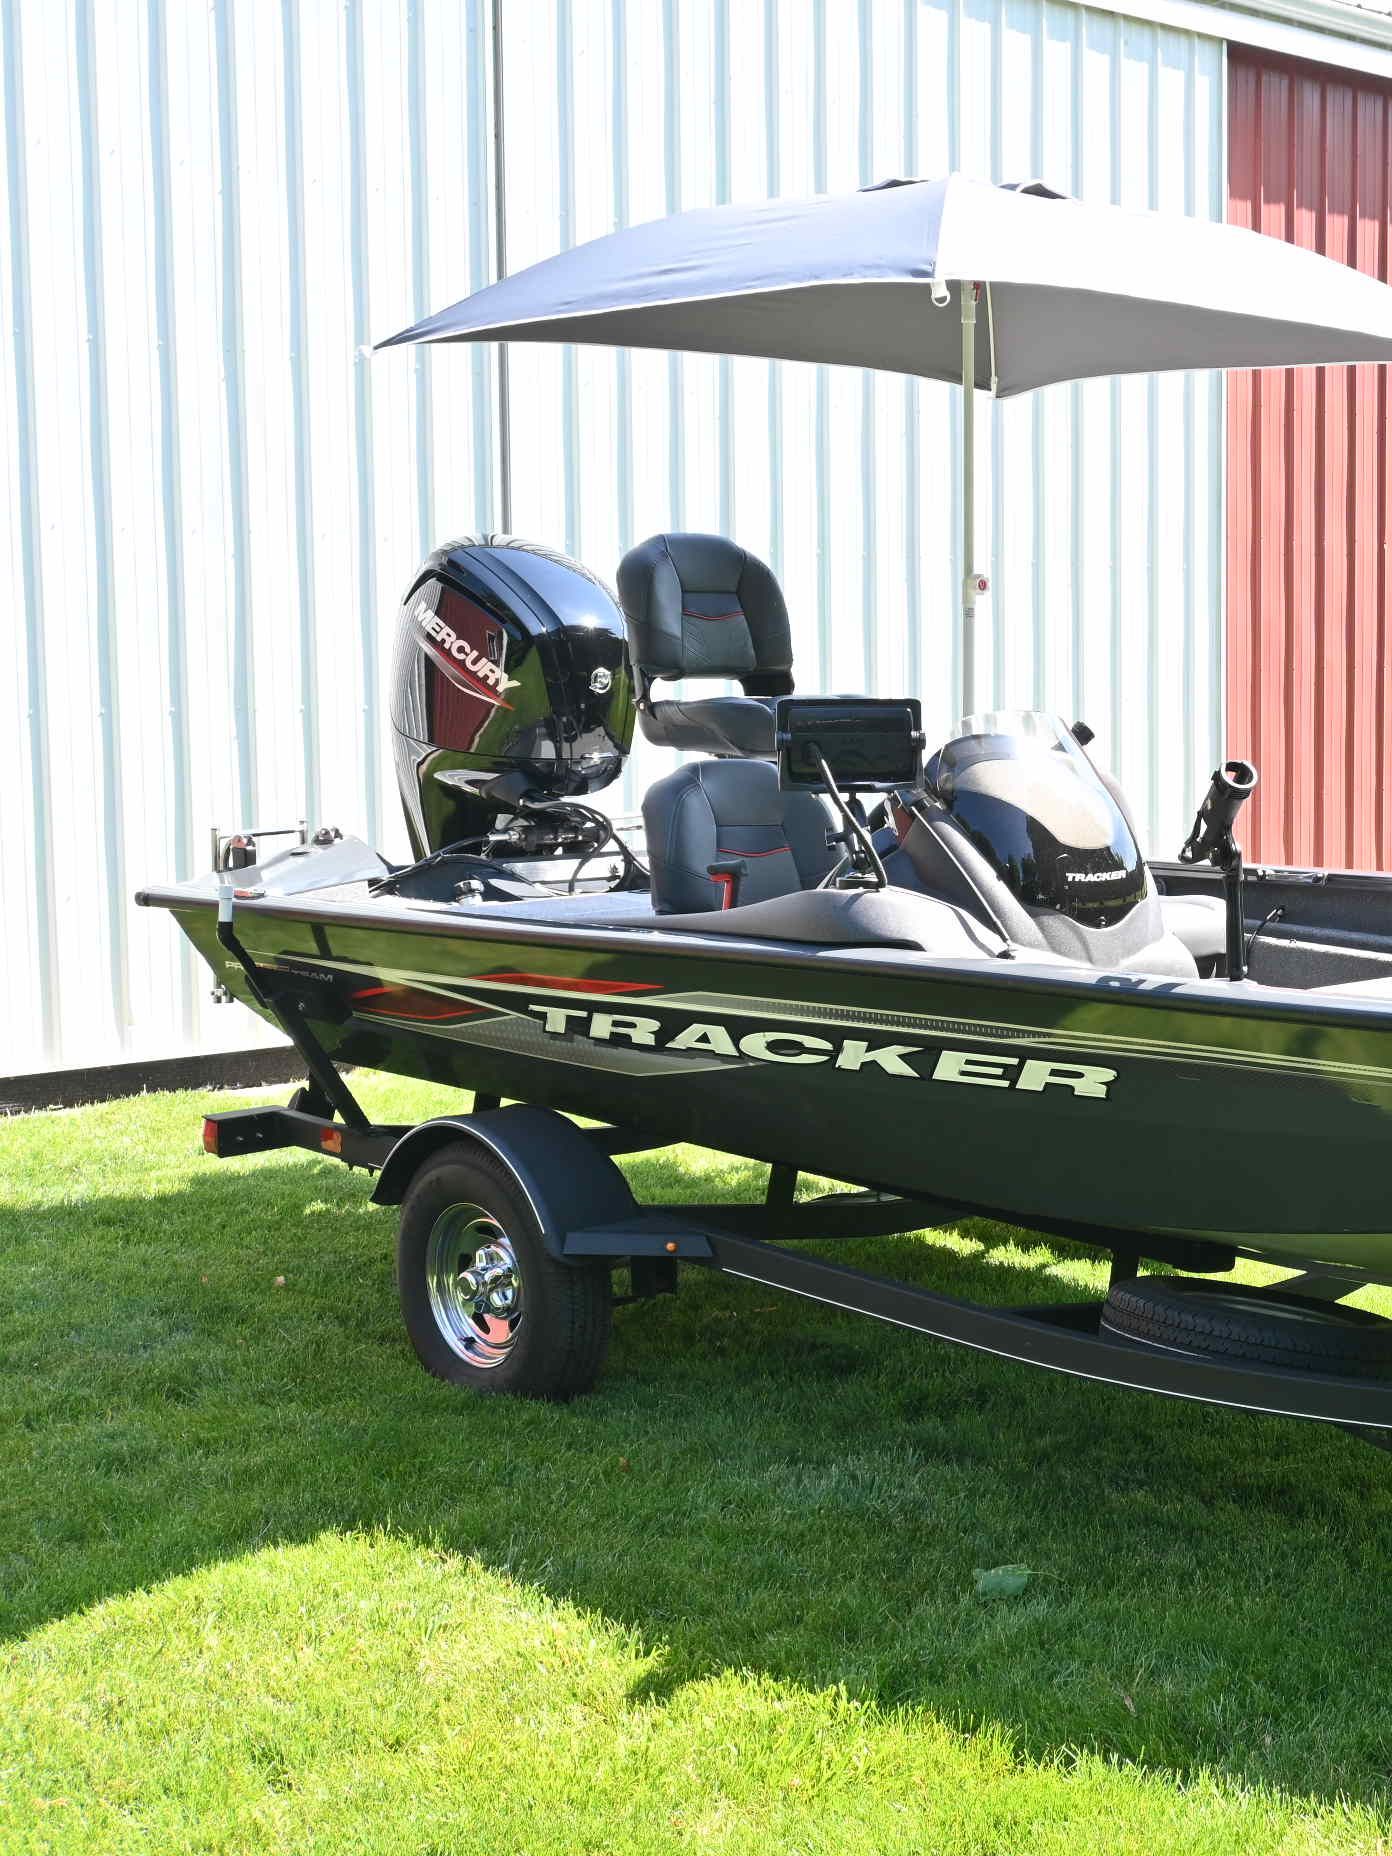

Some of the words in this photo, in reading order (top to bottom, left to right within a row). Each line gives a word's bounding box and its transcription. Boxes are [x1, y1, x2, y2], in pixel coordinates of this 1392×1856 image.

[414, 600, 521, 693] MERCURY
[1065, 869, 1127, 882] TRACKER
[528, 1004, 1118, 1099] TRACKER
